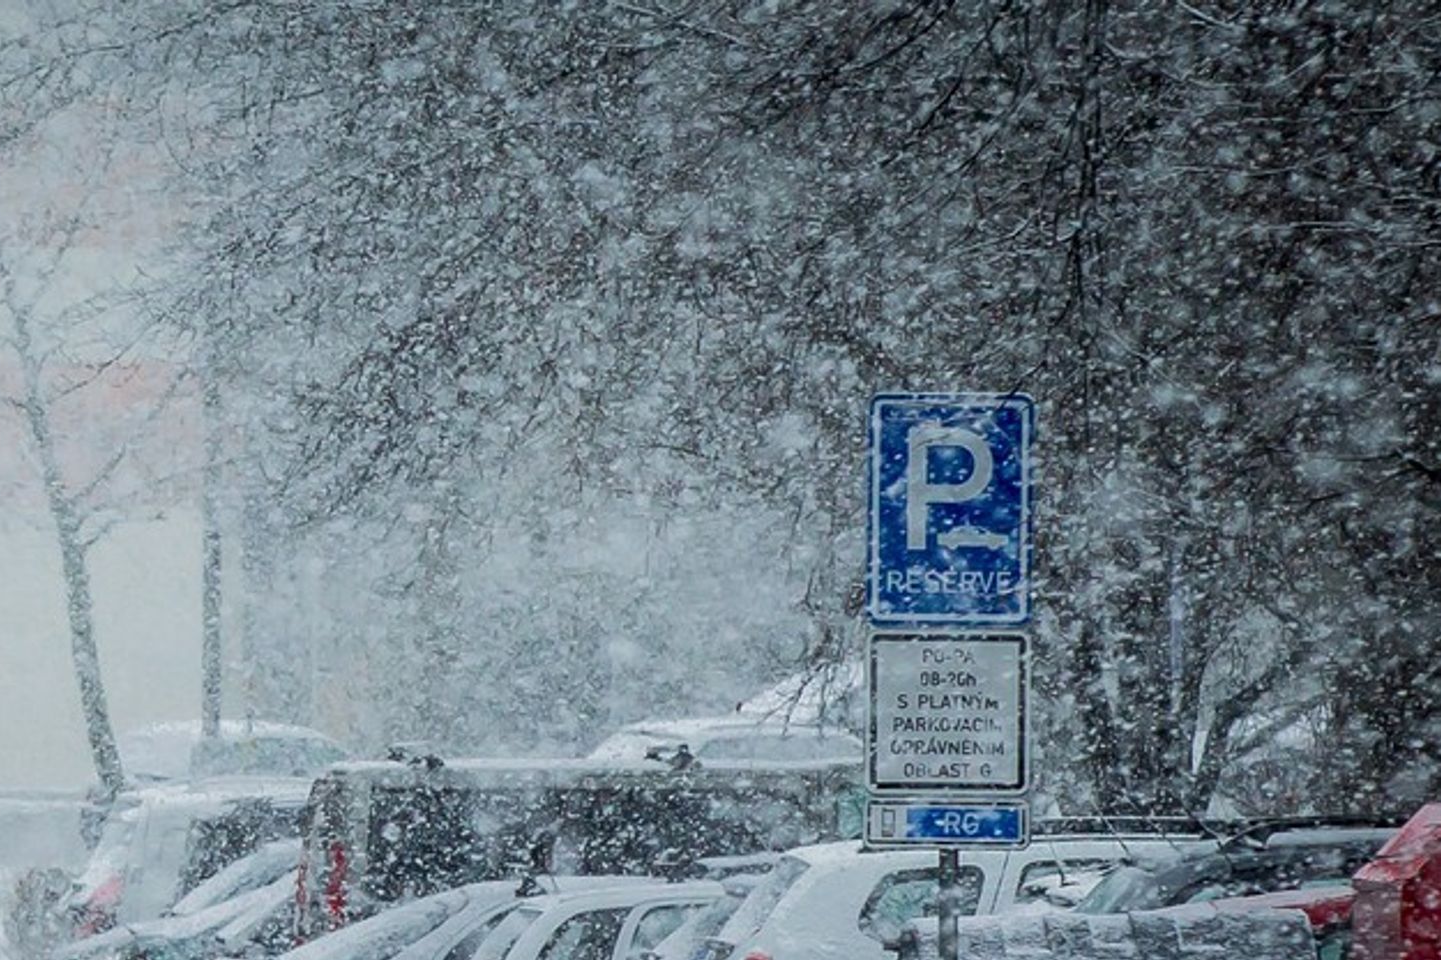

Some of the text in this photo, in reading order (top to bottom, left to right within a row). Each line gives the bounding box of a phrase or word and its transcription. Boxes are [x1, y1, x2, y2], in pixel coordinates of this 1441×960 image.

[906, 427, 994, 550] P
[896, 693, 909, 709] S
[903, 762, 993, 778] OBLAST G
[943, 812, 980, 836] RG
